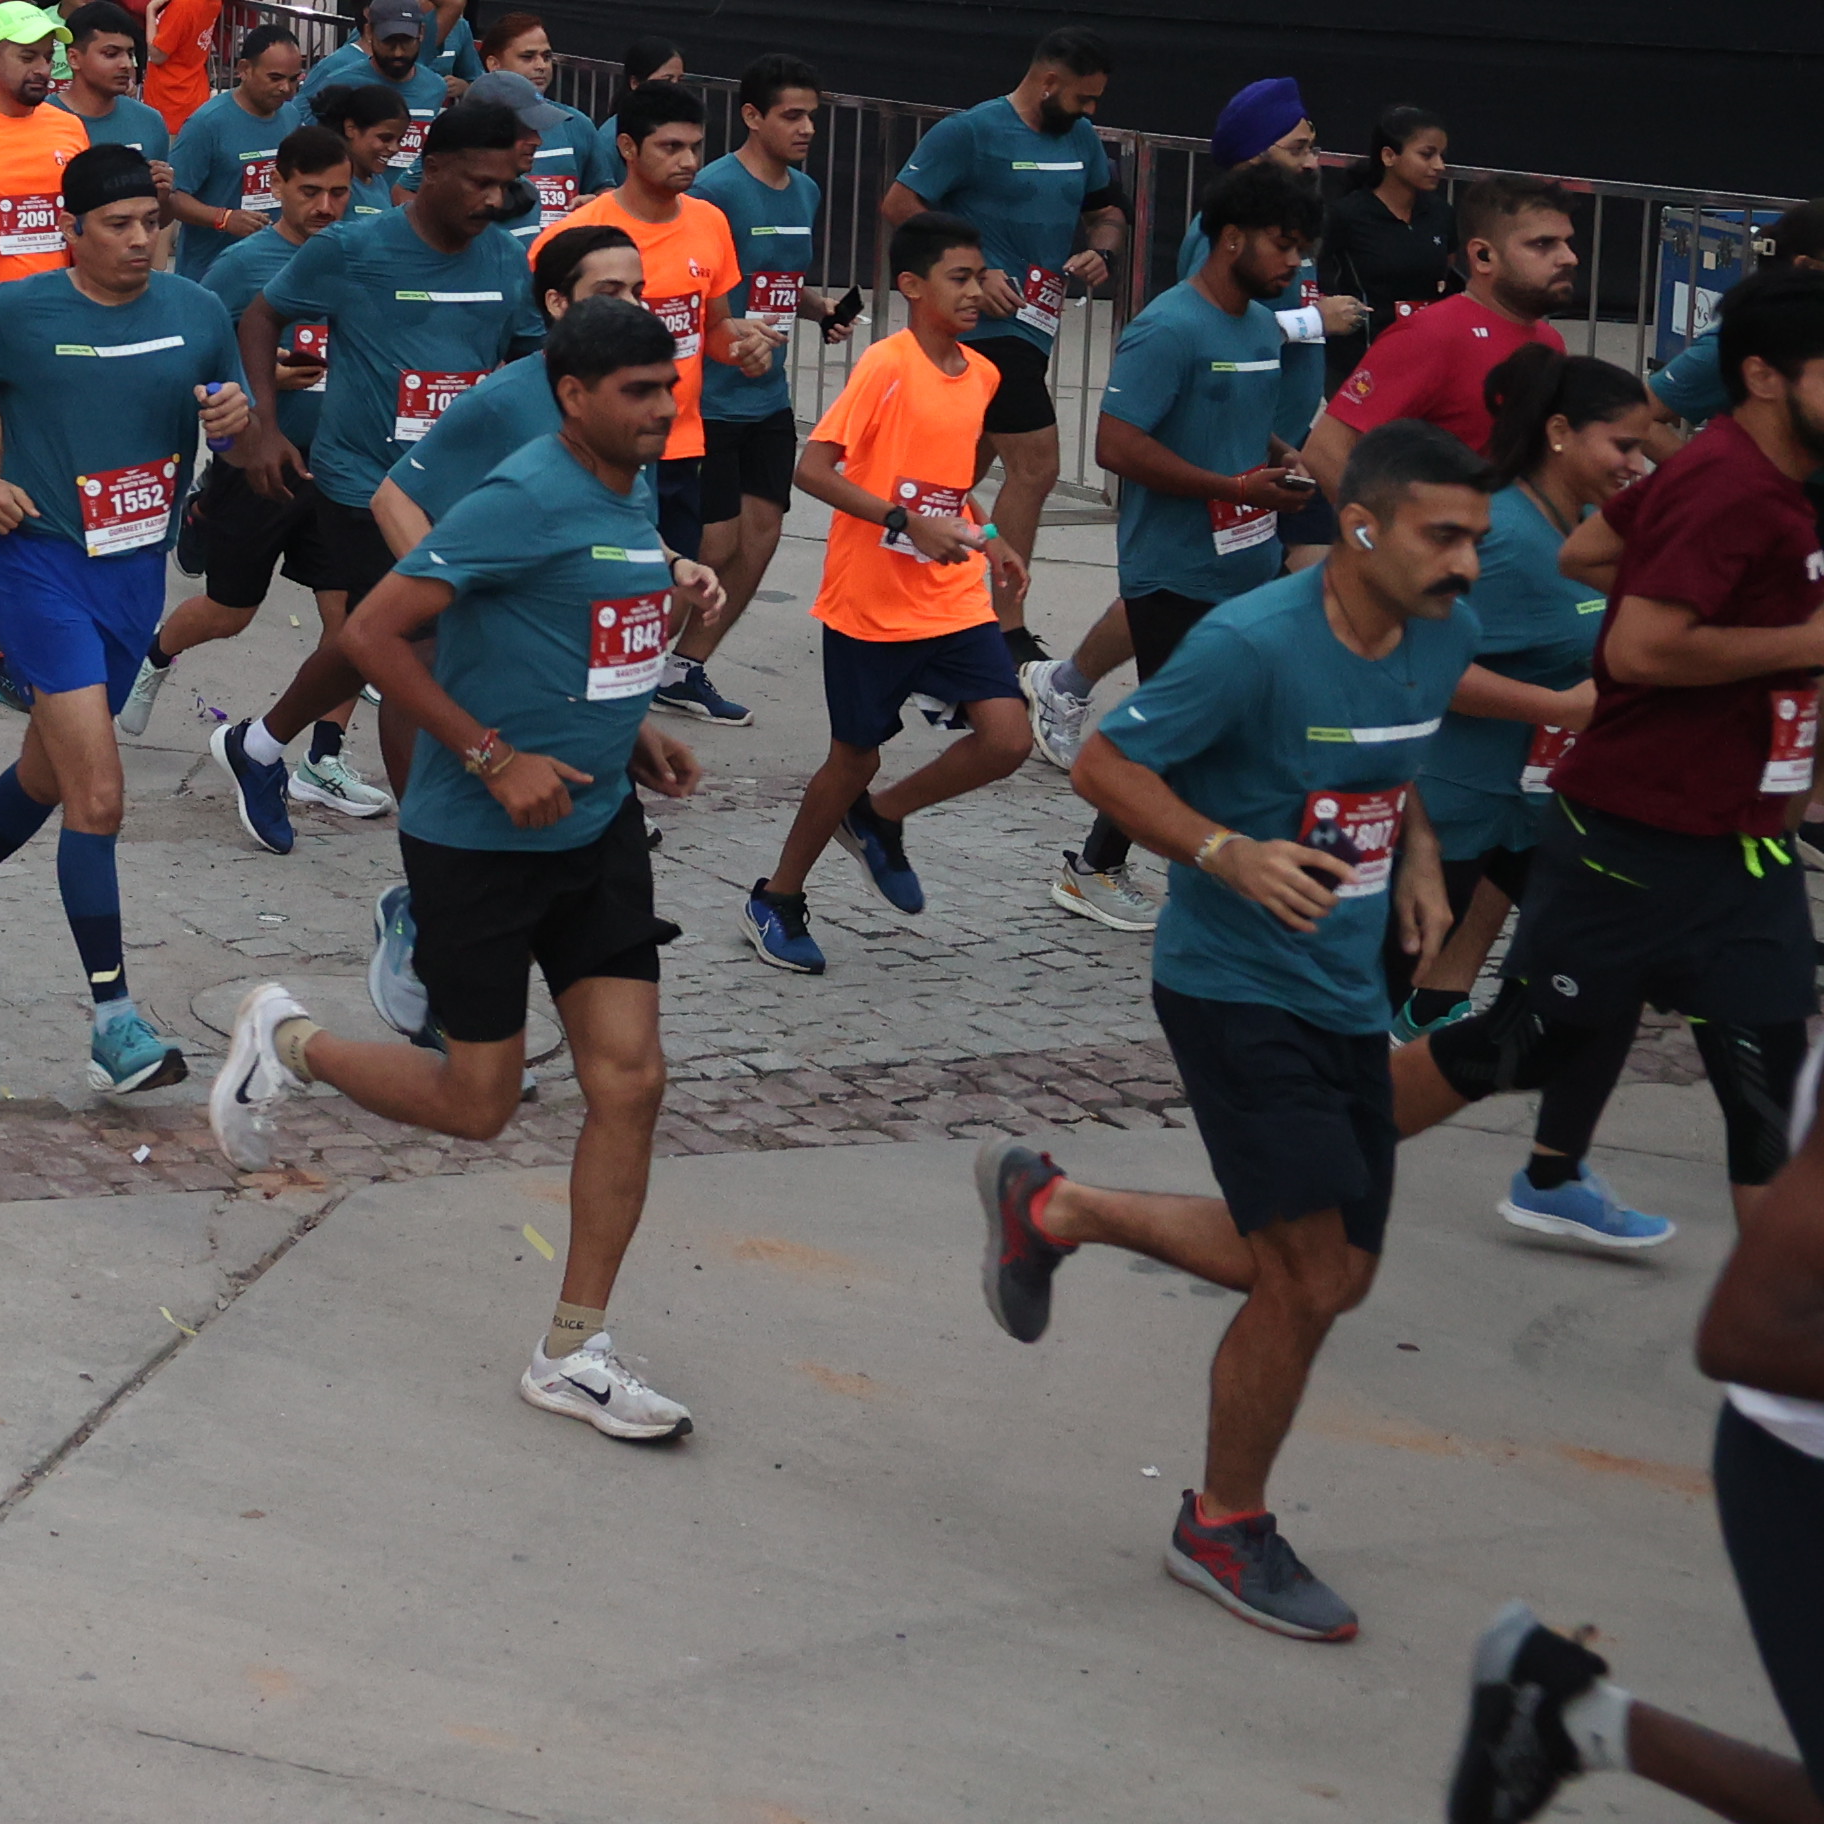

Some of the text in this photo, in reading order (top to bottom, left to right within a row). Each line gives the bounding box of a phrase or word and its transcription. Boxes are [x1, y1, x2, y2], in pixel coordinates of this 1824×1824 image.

[540, 190, 566, 206] 539
[16, 209, 56, 229] 2091
[768, 289, 796, 307] 1724
[110, 482, 165, 517] 1552
[620, 619, 661, 653] 1842
